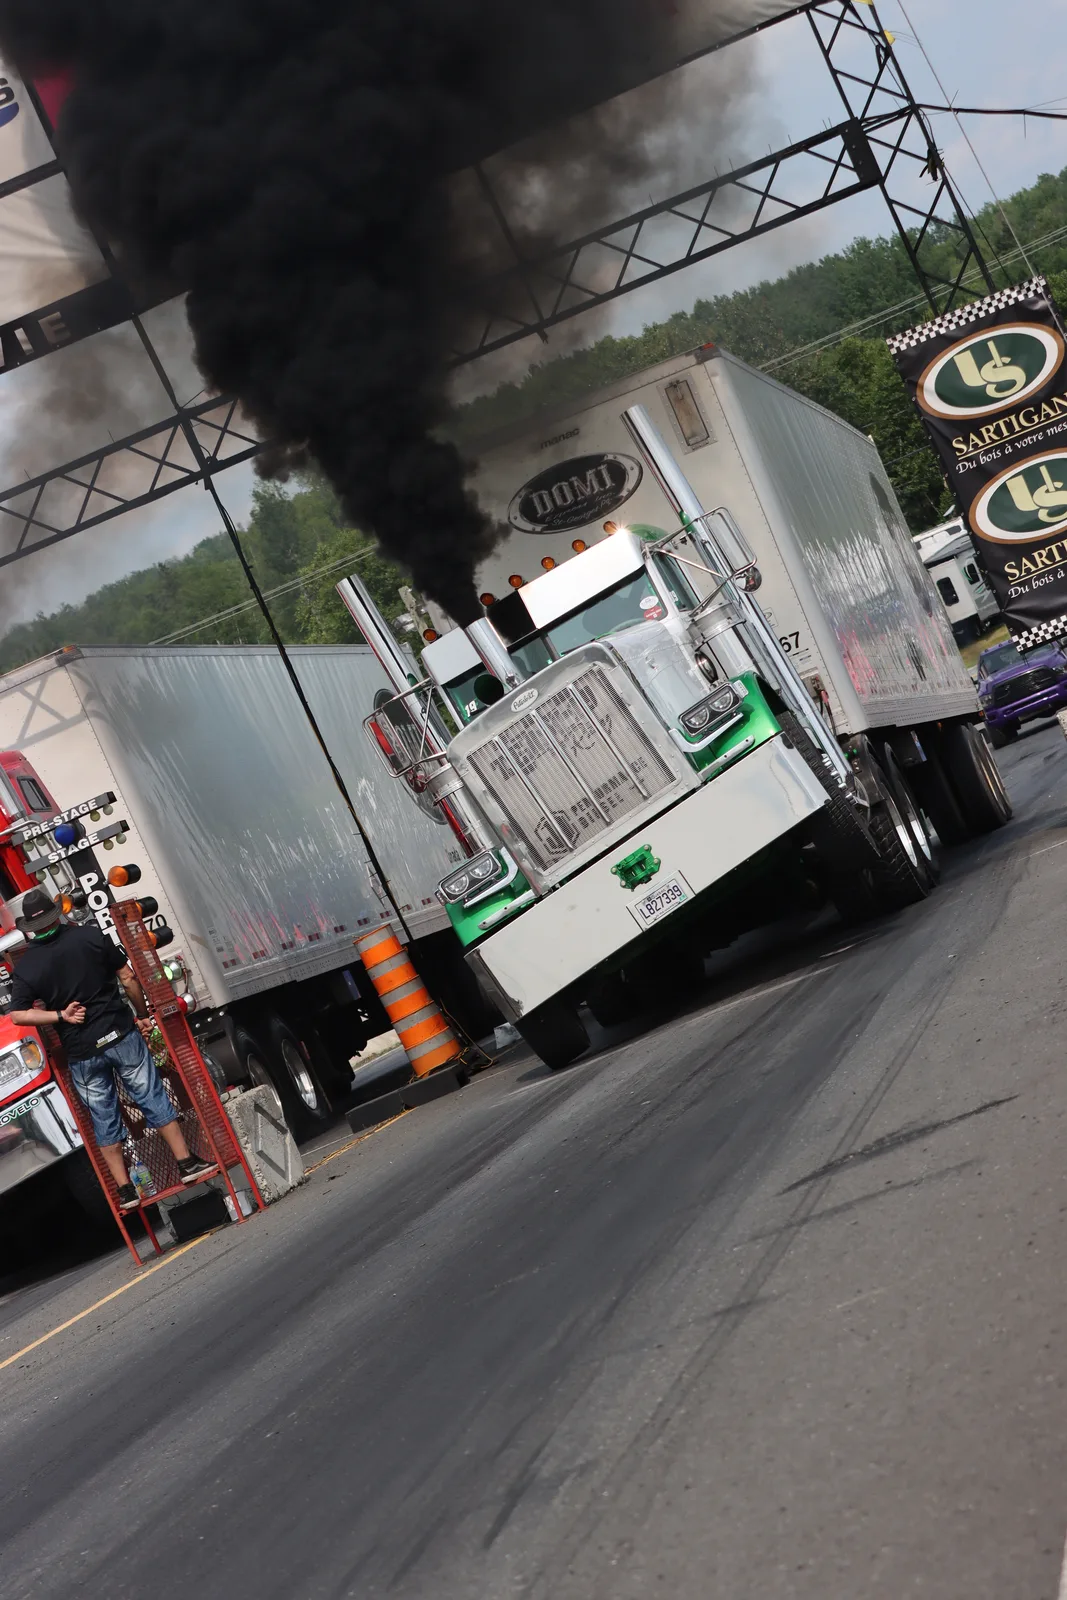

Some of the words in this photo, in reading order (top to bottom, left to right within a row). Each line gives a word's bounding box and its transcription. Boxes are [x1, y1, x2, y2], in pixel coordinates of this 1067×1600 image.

[540, 428, 580, 449] manac
[955, 460, 977, 474] Du
[979, 449, 1002, 465] bois
[1004, 444, 1013, 455] à
[1014, 430, 1045, 449] votre
[529, 463, 616, 518] DOMI
[1008, 586, 1030, 599] Du
[1031, 573, 1054, 590] bois
[1057, 568, 1065, 579] à
[464, 700, 478, 718] 19
[570, 756, 648, 816] PERORMACE
[22, 799, 98, 840] PRE-STAGE
[47, 832, 100, 863] STAGE
[639, 884, 683, 919] L827339
